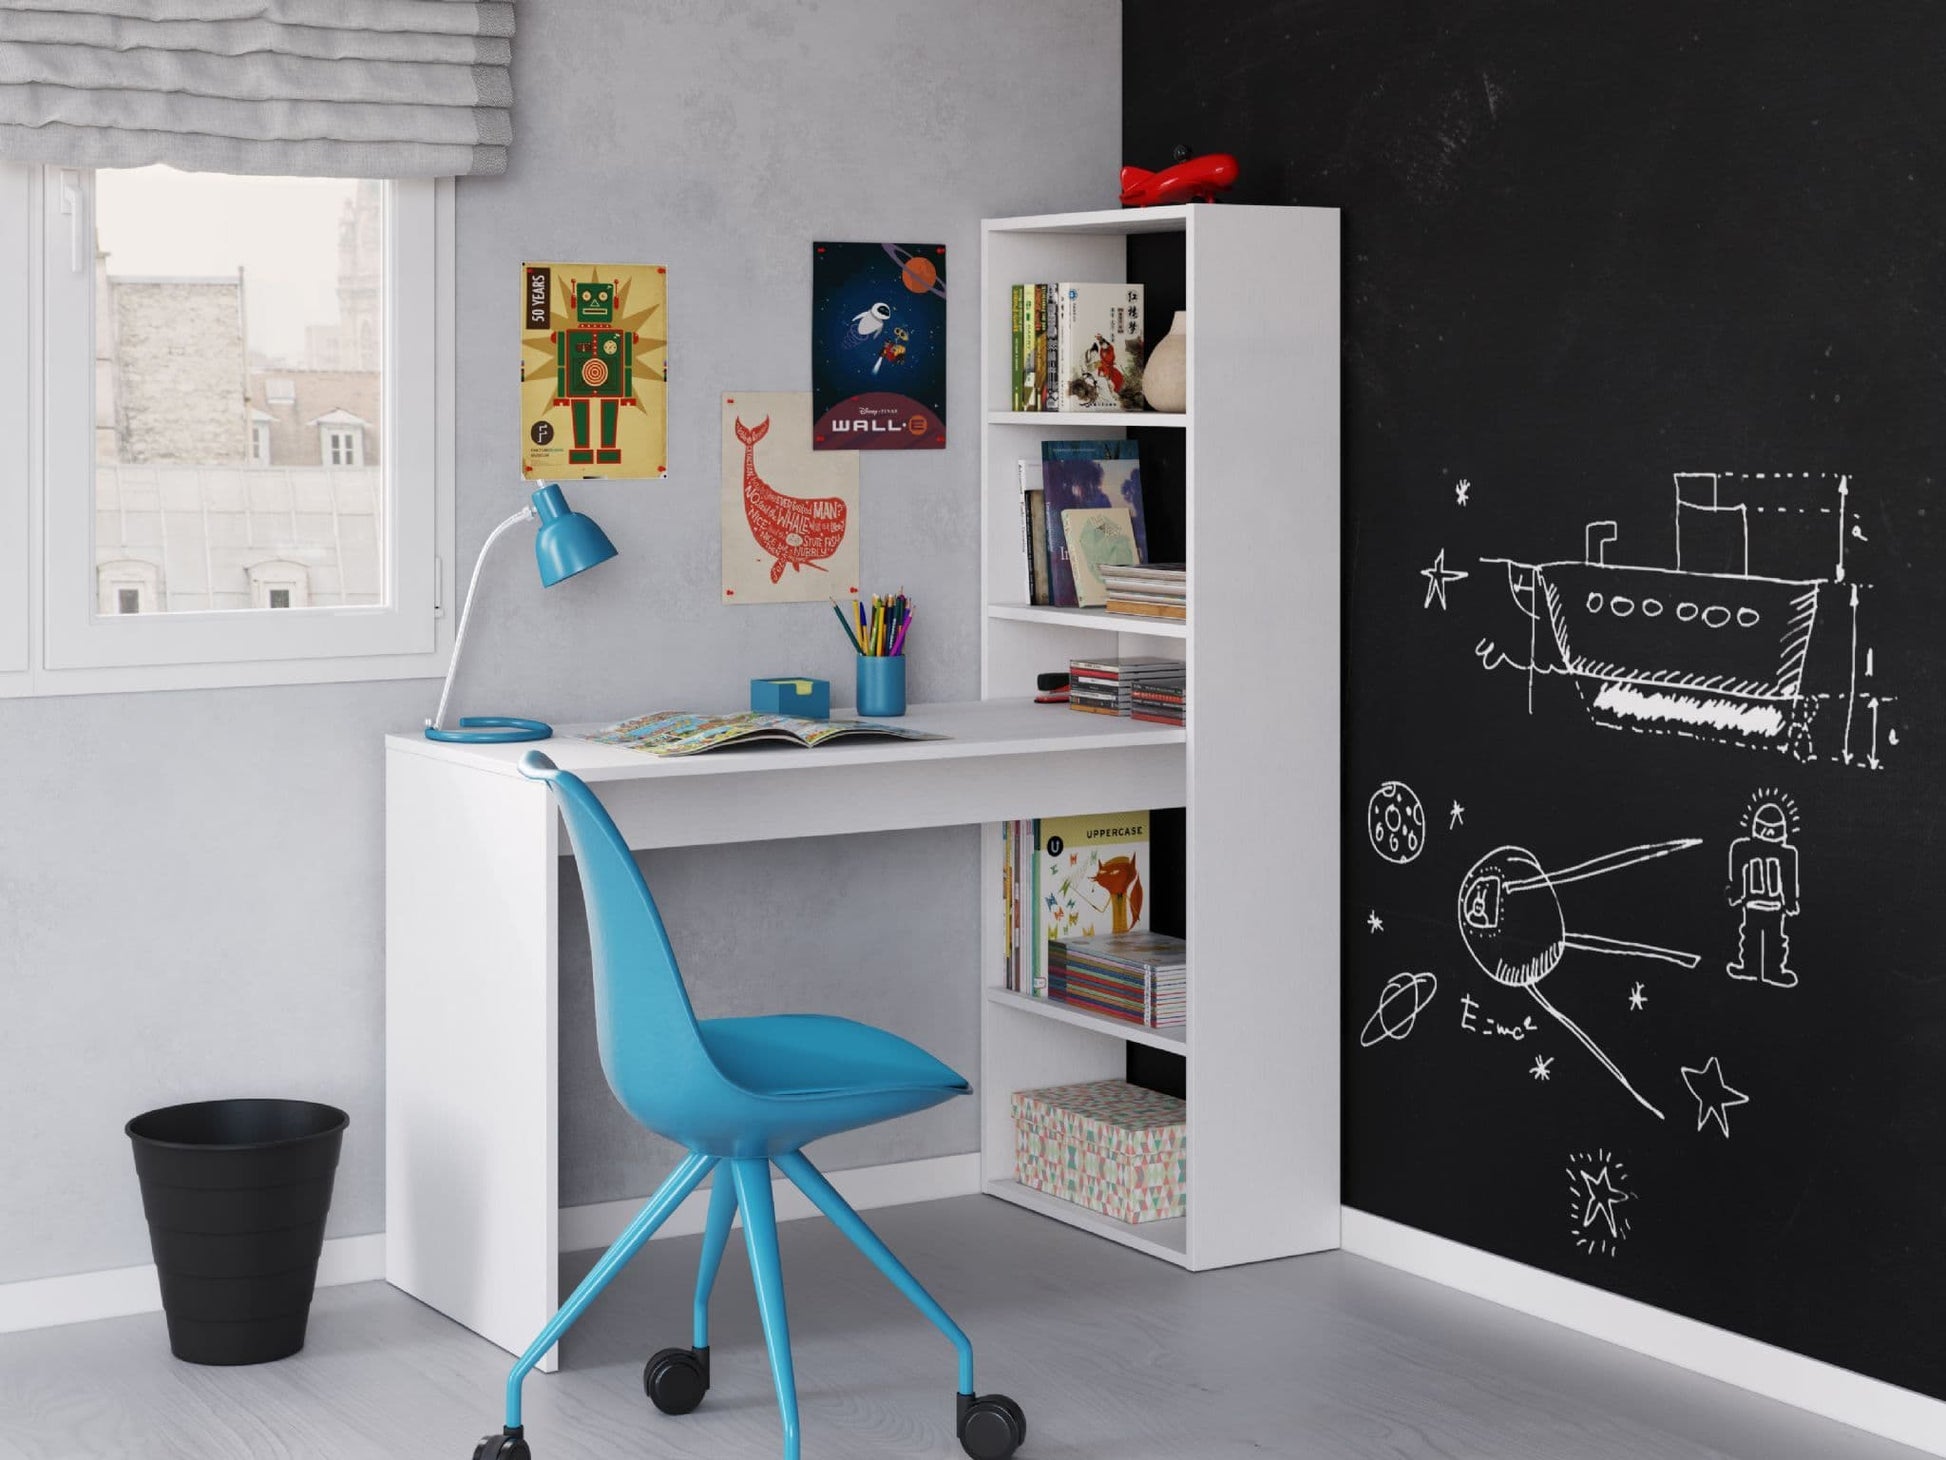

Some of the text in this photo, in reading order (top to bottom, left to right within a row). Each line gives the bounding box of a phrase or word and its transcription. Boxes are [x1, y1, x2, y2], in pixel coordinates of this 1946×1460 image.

[531, 274, 546, 322] 50 YEARS
[1086, 825, 1143, 840] UPPERCASE
